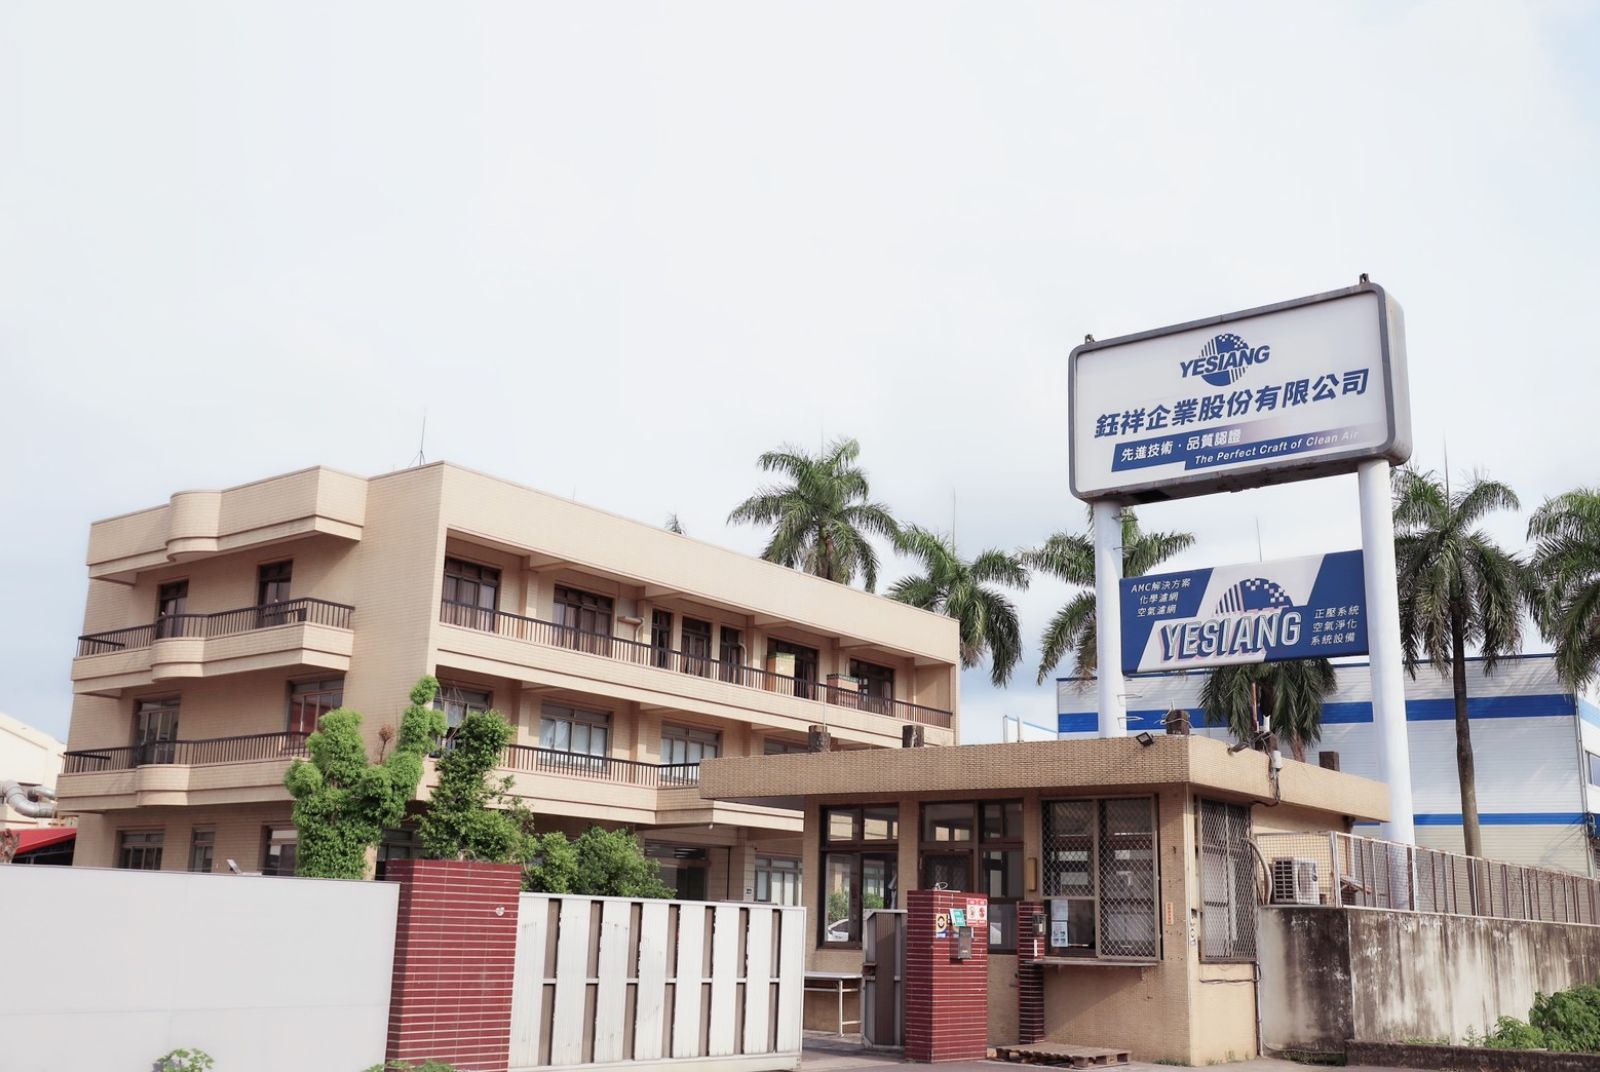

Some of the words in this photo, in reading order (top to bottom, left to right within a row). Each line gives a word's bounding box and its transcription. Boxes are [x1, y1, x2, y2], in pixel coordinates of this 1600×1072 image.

[1180, 345, 1270, 378] YESIANG
[1094, 368, 1370, 438] 鈺祥企業股份有限公司
[1195, 455, 1214, 465] The
[1217, 446, 1257, 461] Perfect
[1260, 442, 1288, 455] Craft
[1290, 439, 1303, 450] of
[1306, 432, 1338, 447] Clean
[1342, 430, 1359, 442] Air
[1162, 611, 1302, 658] YESIANG
